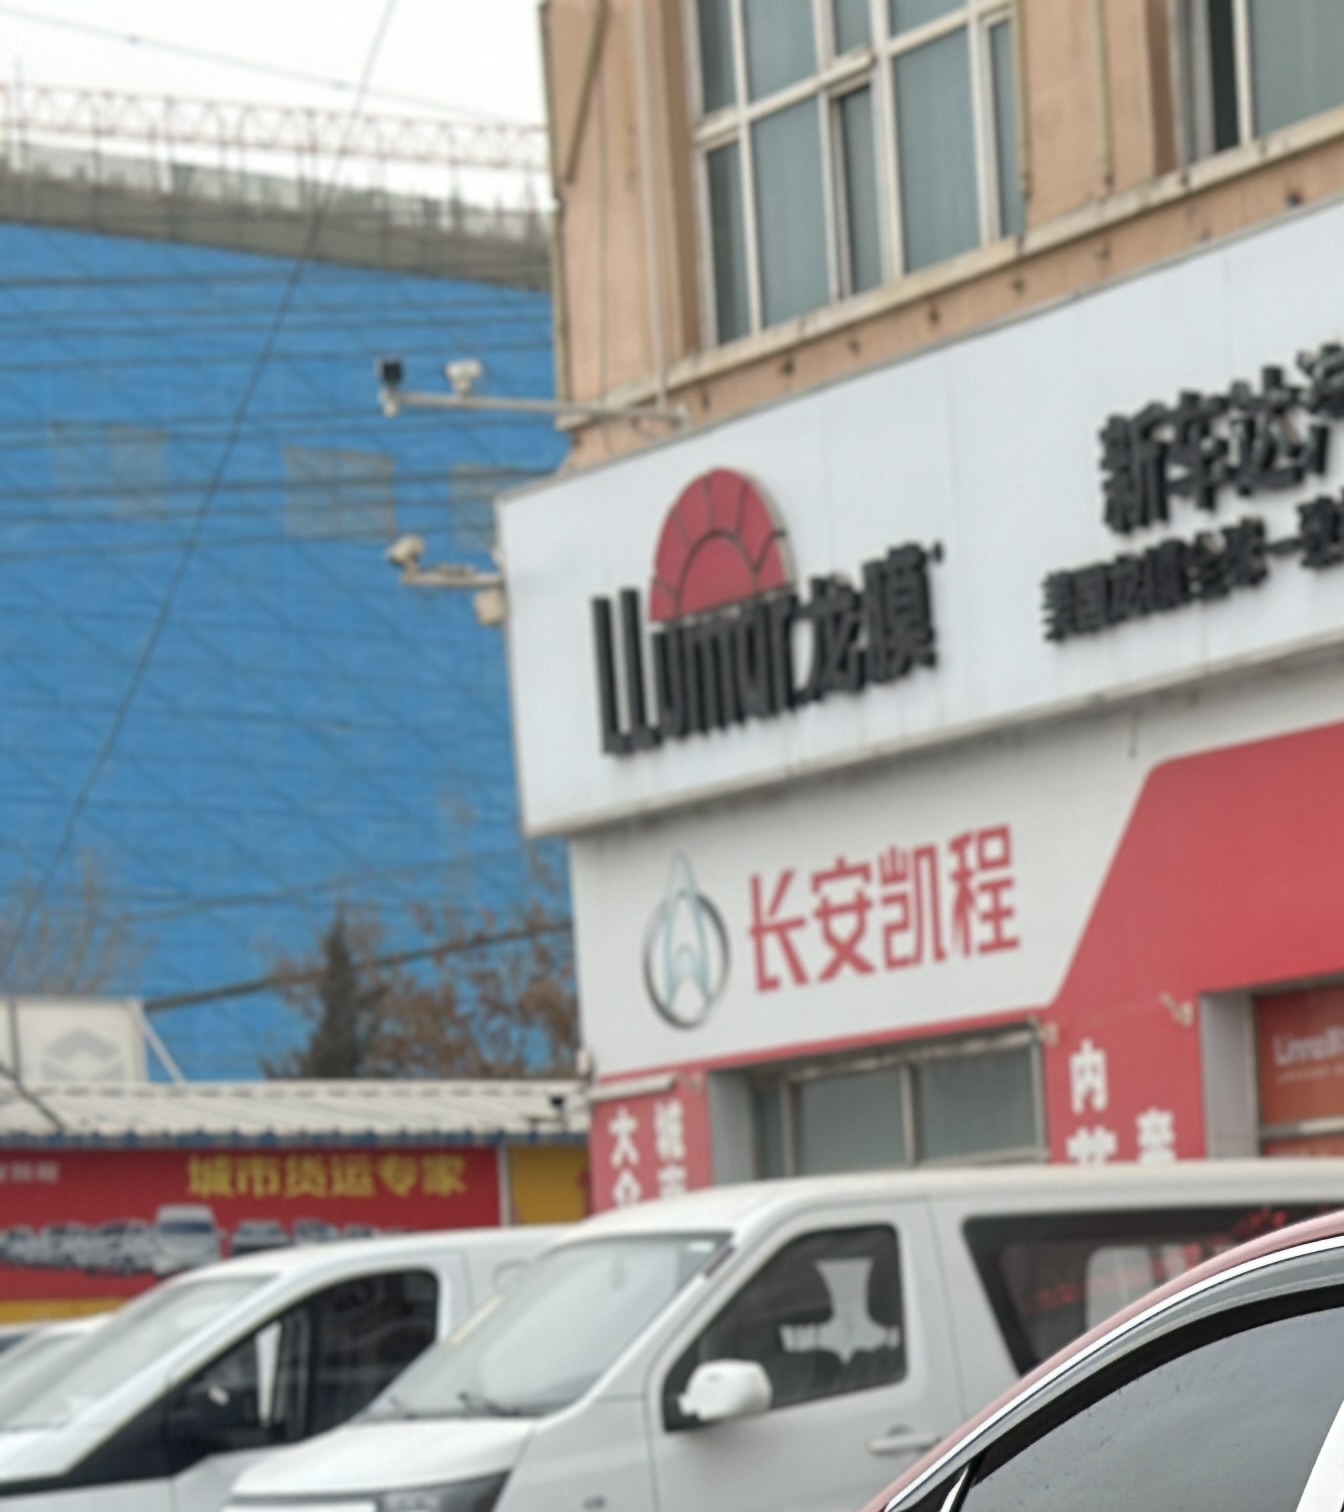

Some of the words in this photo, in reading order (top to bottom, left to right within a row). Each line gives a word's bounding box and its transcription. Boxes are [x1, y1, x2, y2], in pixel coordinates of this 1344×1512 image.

[749, 825, 1020, 993] 长安凯程
[186, 1154, 467, 1197] 城市货运专家
